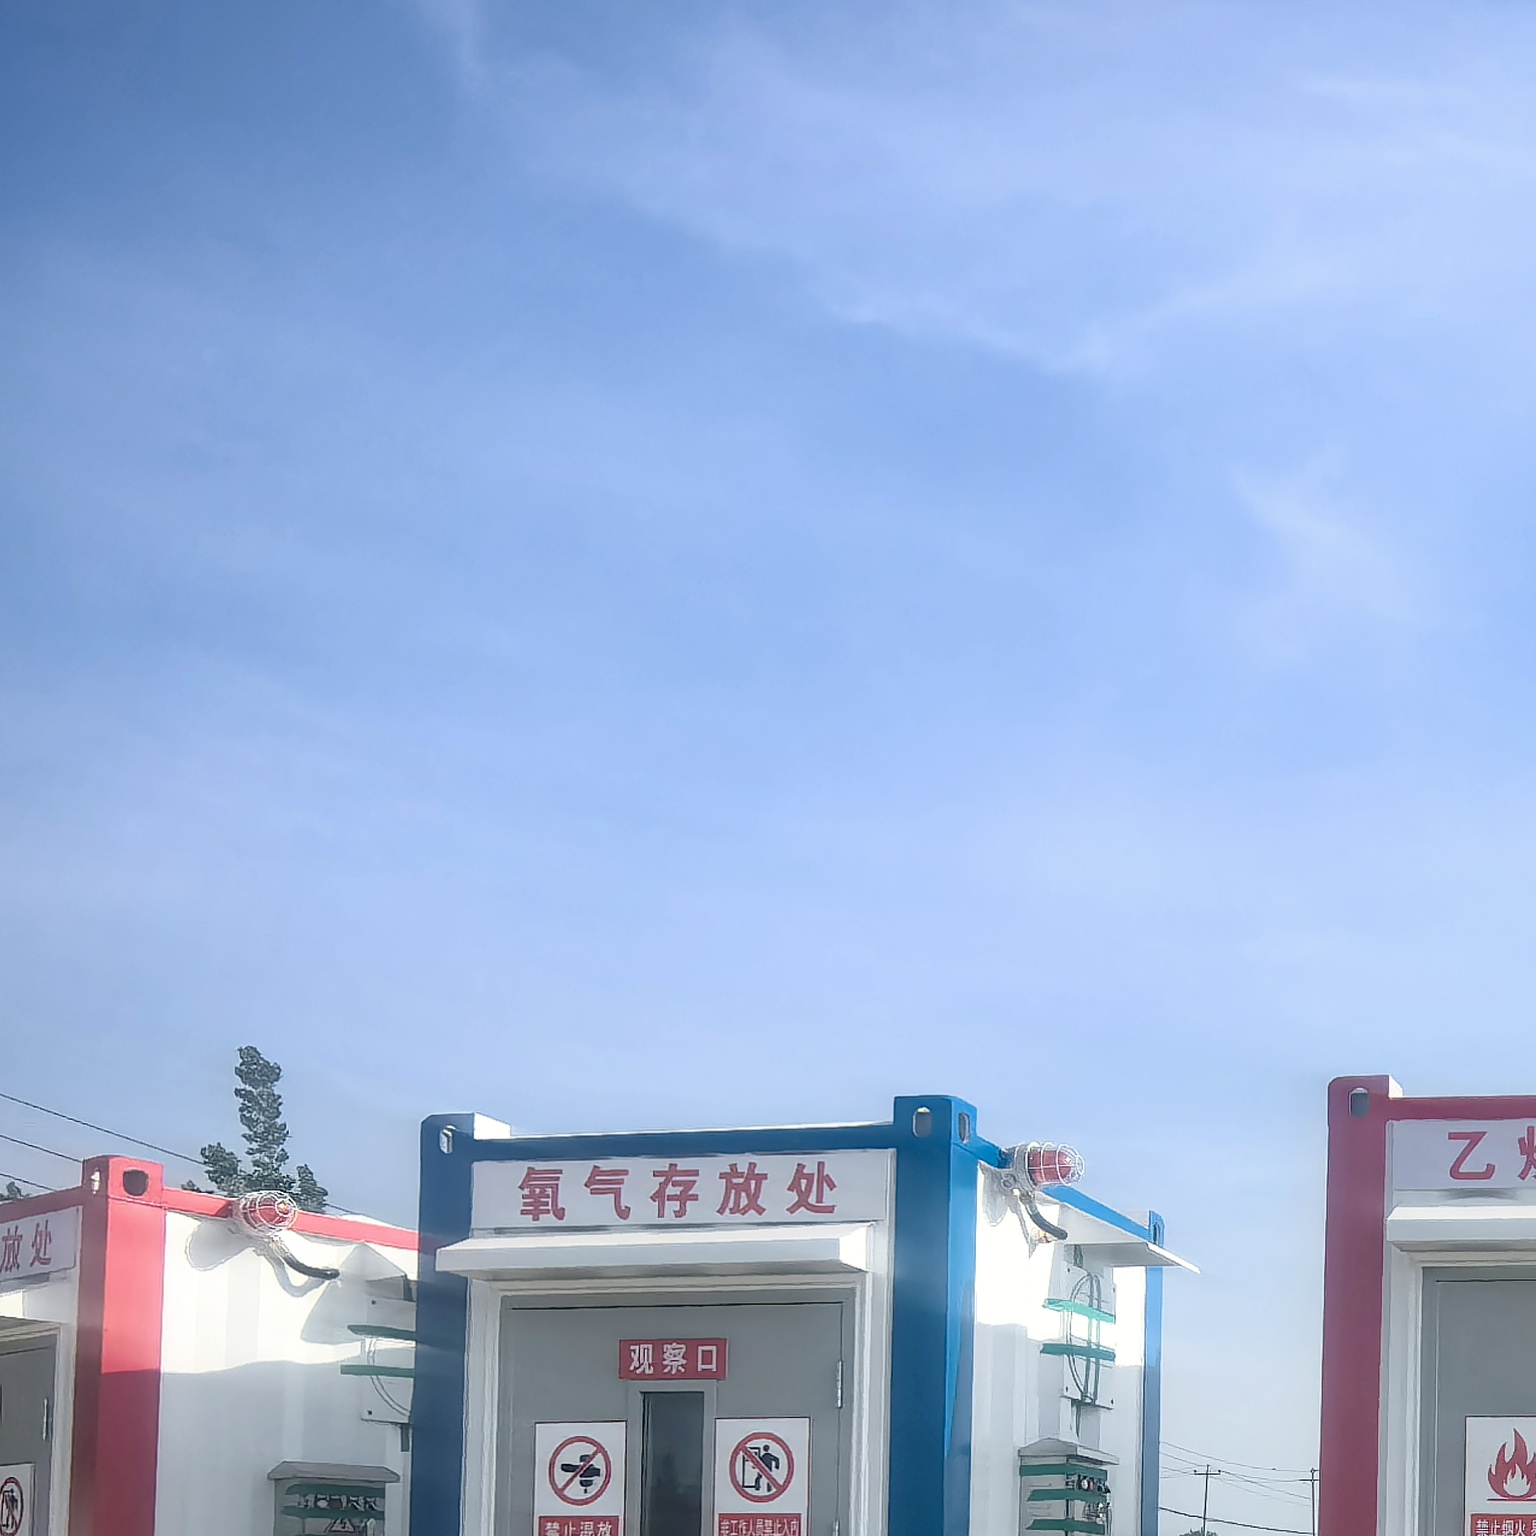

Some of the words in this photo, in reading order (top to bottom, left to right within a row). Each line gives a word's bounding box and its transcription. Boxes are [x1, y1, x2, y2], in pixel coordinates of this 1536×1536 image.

[517, 1161, 838, 1222] 氧气存放处
[0, 1219, 52, 1273] 放处
[629, 1342, 717, 1375] 观察口
